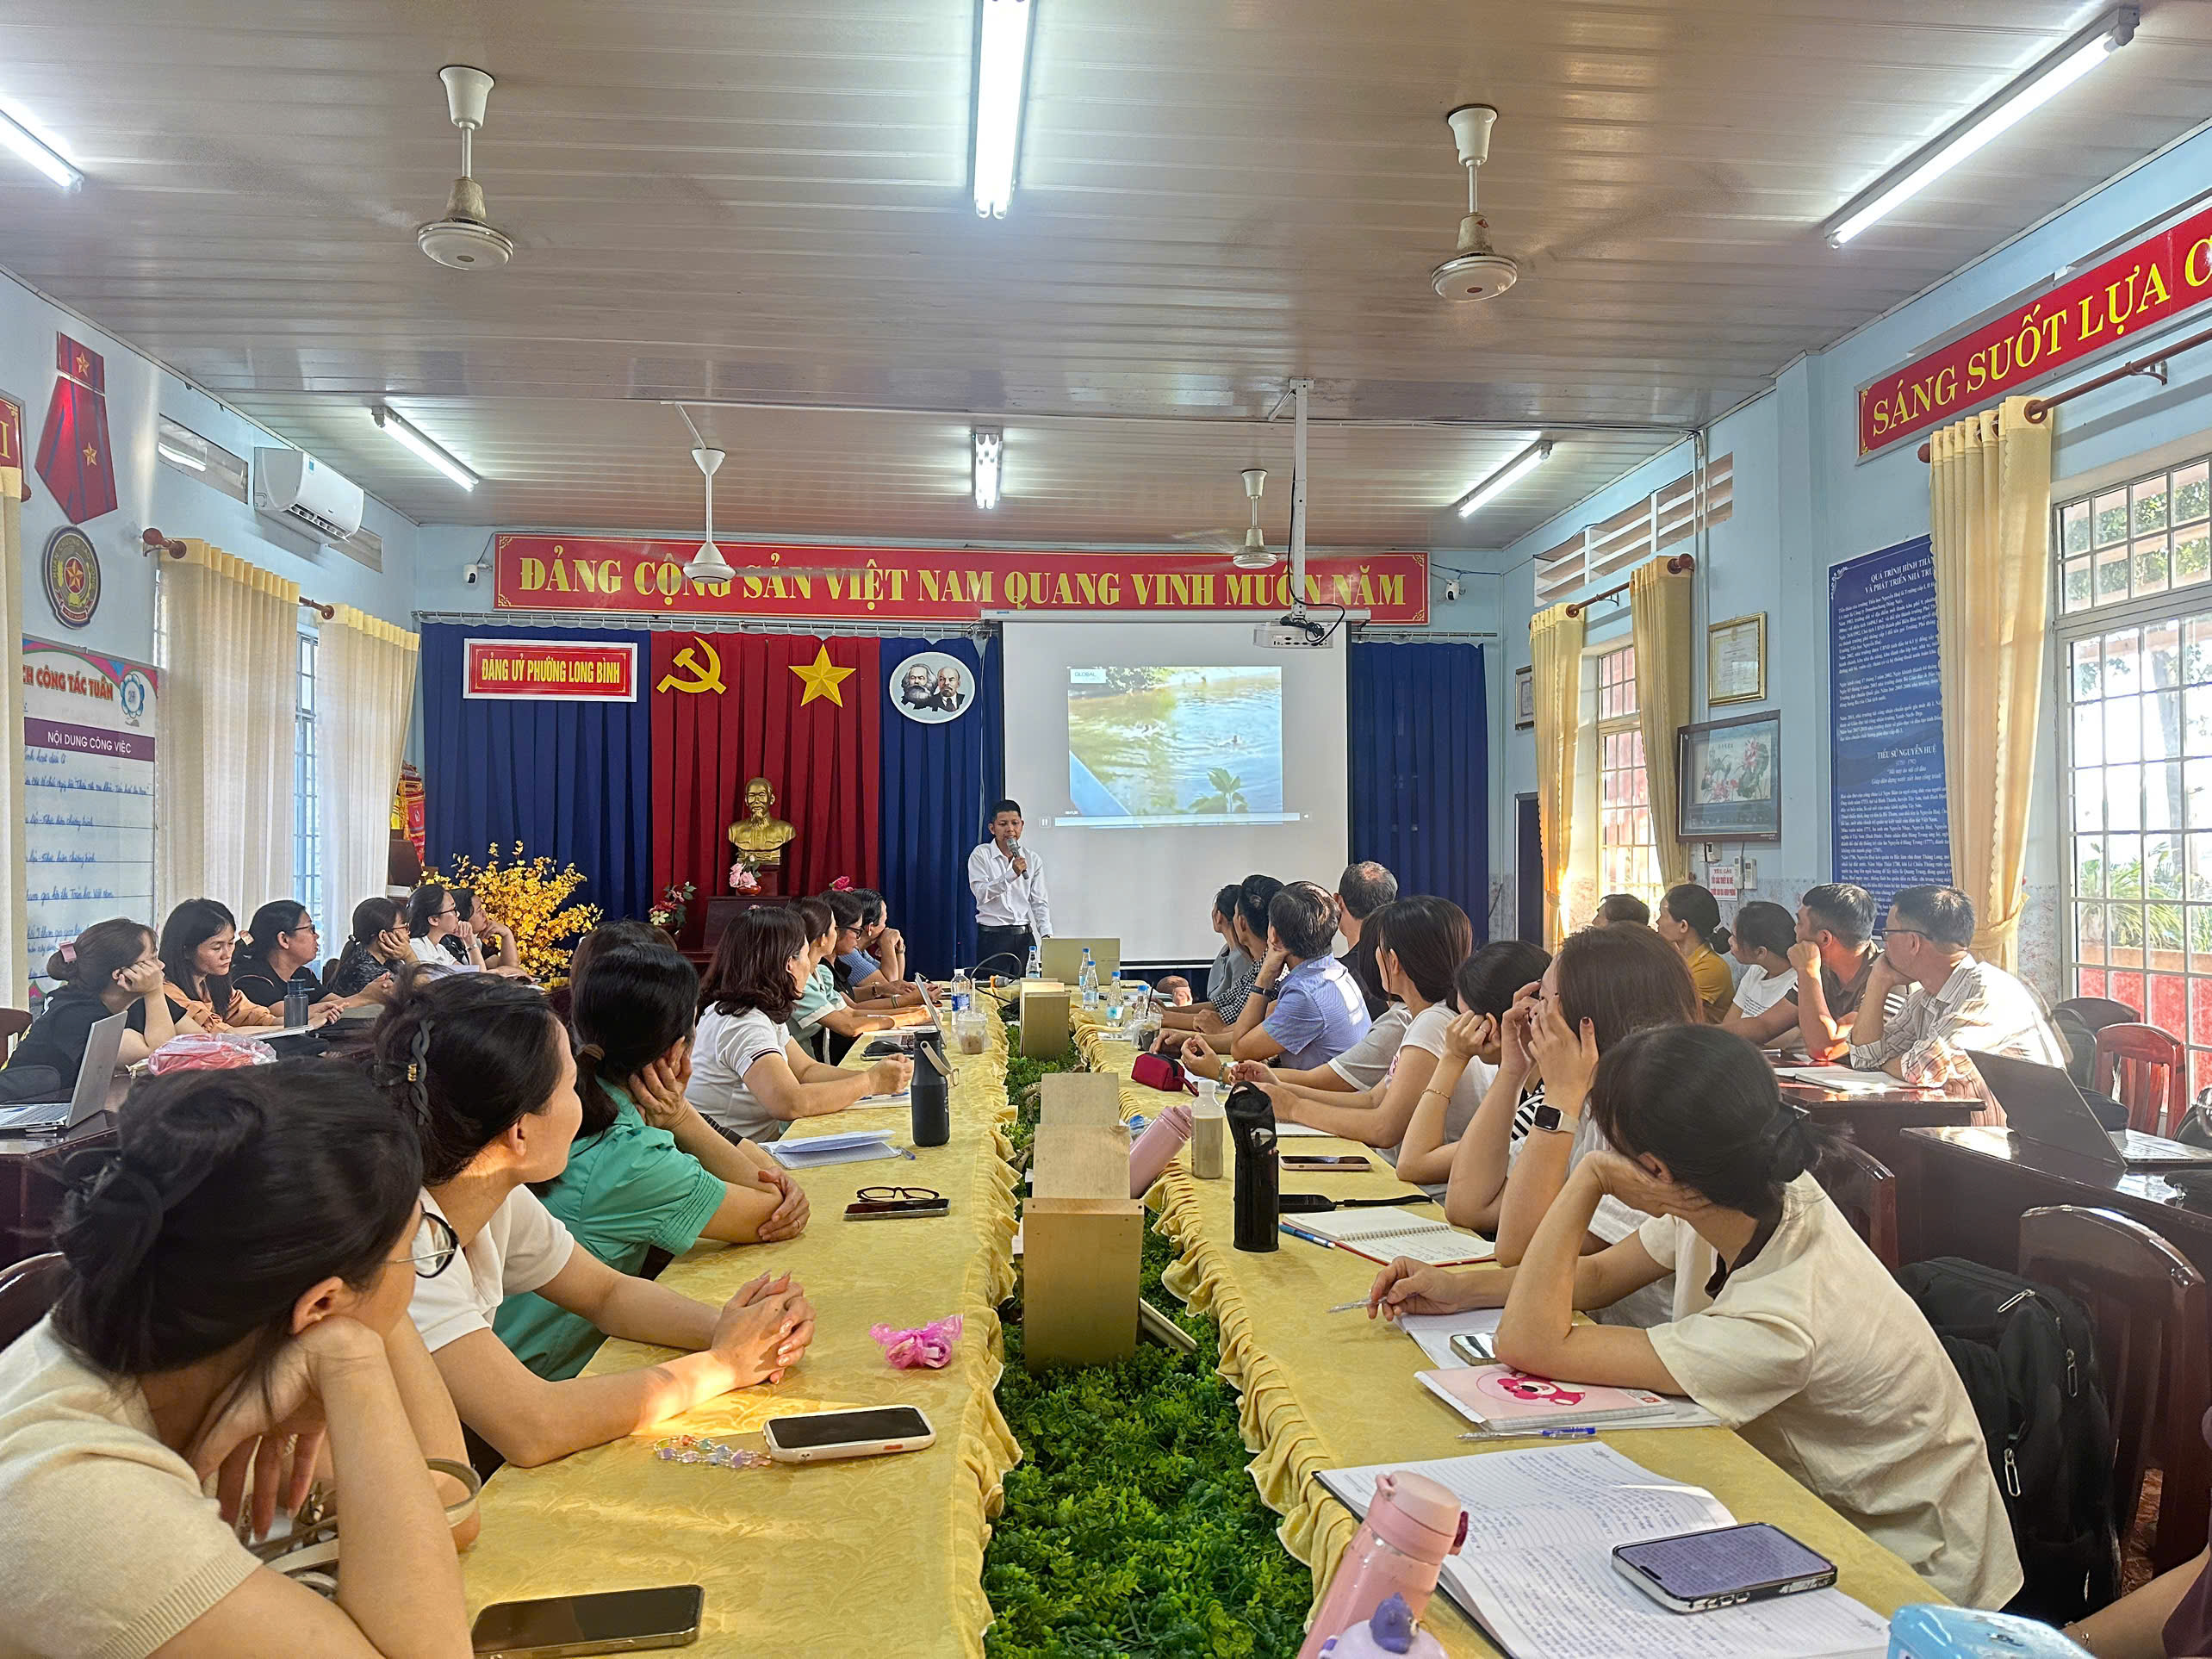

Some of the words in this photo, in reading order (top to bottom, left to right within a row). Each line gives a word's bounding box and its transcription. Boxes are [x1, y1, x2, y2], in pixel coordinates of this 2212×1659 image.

[1873, 365, 1959, 437] SÁNG
[1967, 304, 2067, 394] SUỐT
[2078, 263, 2171, 341] LỰA
[519, 545, 623, 593] ĐẢNG
[743, 552, 812, 599] SẢN
[823, 558, 908, 611] VIỆT
[917, 569, 994, 602] NAM
[1004, 571, 1121, 610] QUANG
[1130, 574, 1215, 605] VINH
[1332, 565, 1406, 605] NĂM
[36, 665, 66, 693] CÔNG
[482, 652, 508, 680] ĐẢNG
[527, 656, 566, 683] PHƯỜNG
[569, 661, 594, 683] LONG
[596, 657, 620, 684] BÌNH
[47, 730, 62, 747] NỘI
[64, 736, 88, 748] DUNG
[90, 736, 113, 751] CÔNG
[115, 739, 132, 755] VIỆC
